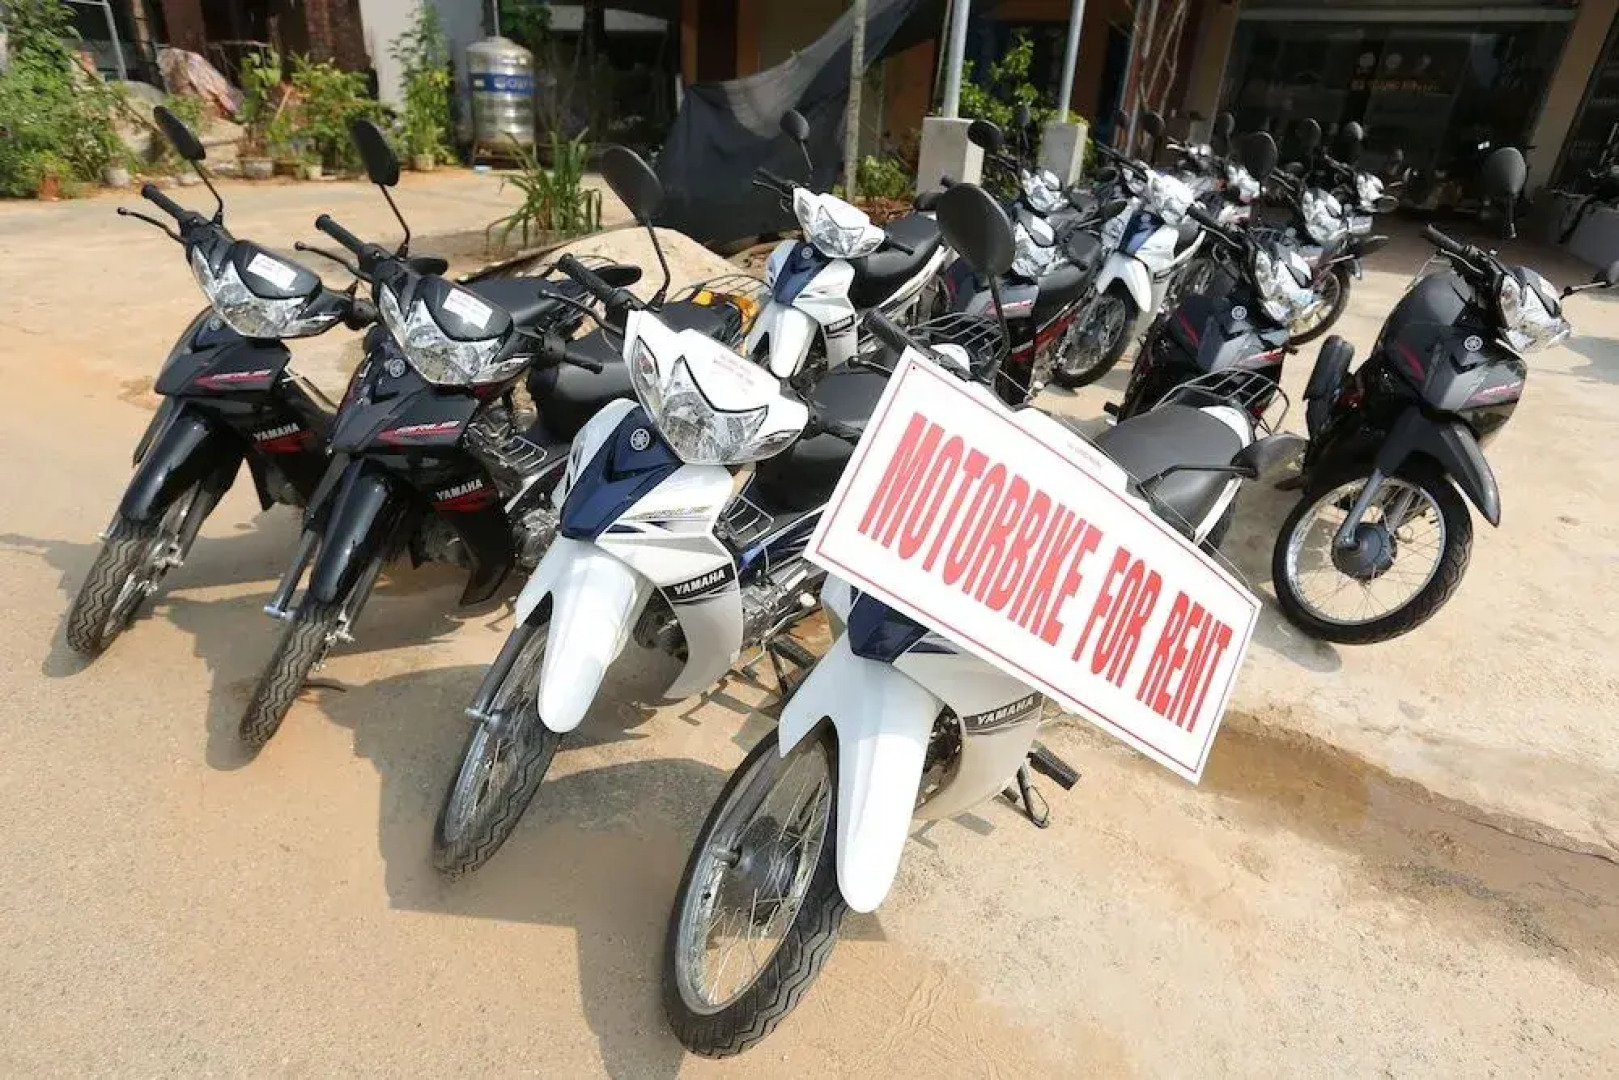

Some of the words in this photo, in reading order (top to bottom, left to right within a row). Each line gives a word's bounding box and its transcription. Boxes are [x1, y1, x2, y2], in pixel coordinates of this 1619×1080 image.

[253, 422, 300, 442] YAMAHA
[435, 478, 484, 501] YAMAHA
[673, 569, 726, 595] YAMAHA
[858, 413, 1104, 647] MOTORBIKE
[1072, 547, 1163, 687] FOR
[1136, 592, 1234, 732] RENT
[976, 695, 1034, 725] YAMAHA
